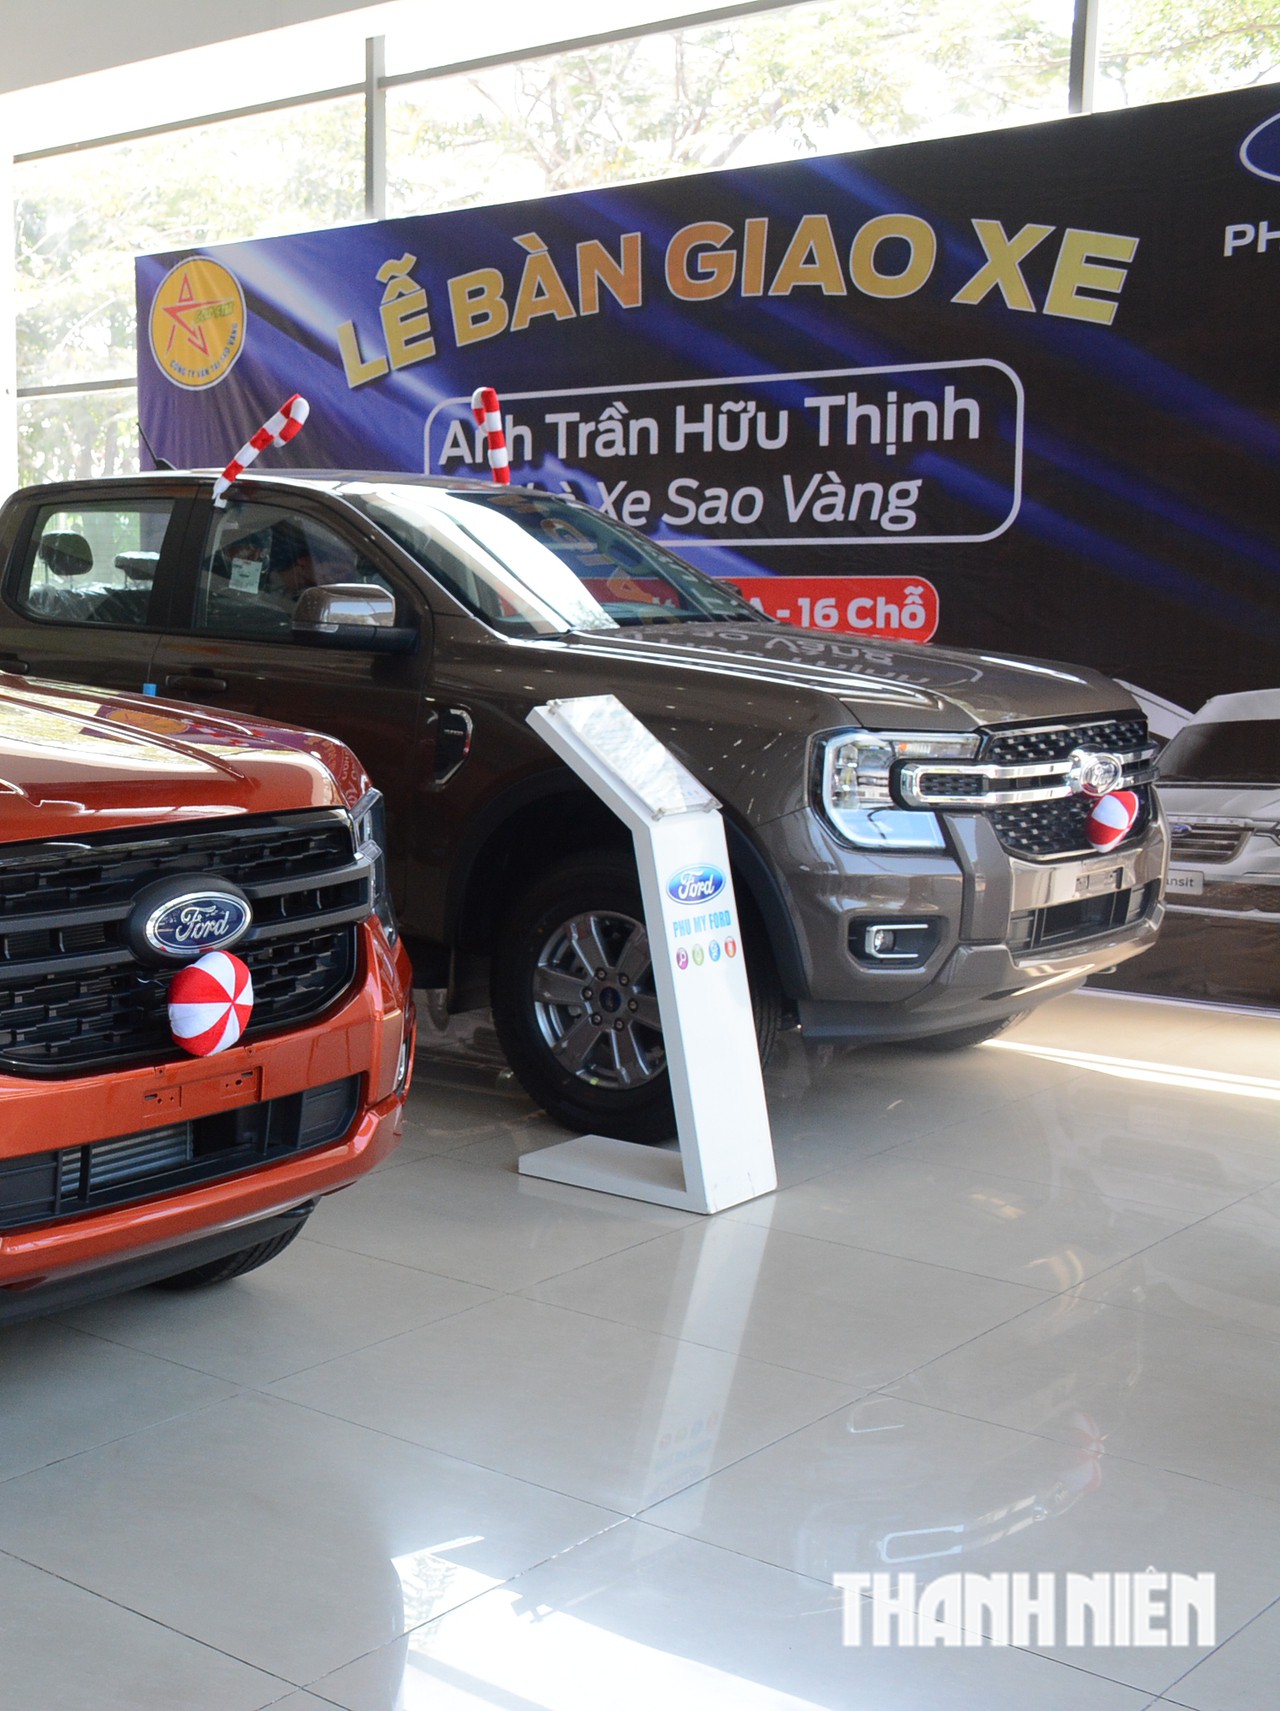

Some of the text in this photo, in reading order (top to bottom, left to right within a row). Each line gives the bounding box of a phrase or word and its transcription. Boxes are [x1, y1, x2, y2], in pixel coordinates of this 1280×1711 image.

[336, 213, 1140, 389] LỄ BÀN GIAO XE
[544, 401, 659, 459] Trần
[675, 400, 789, 453] Hữu
[803, 385, 981, 456] Thịnh
[597, 470, 923, 531] Xe Sao Vàng
[797, 597, 839, 629] 16
[846, 585, 926, 630] Chỗ
[678, 869, 715, 899] Ford
[1166, 877, 1194, 887] nsit
[175, 905, 231, 942] Ford
[673, 910, 732, 938] PHU MY FORD
